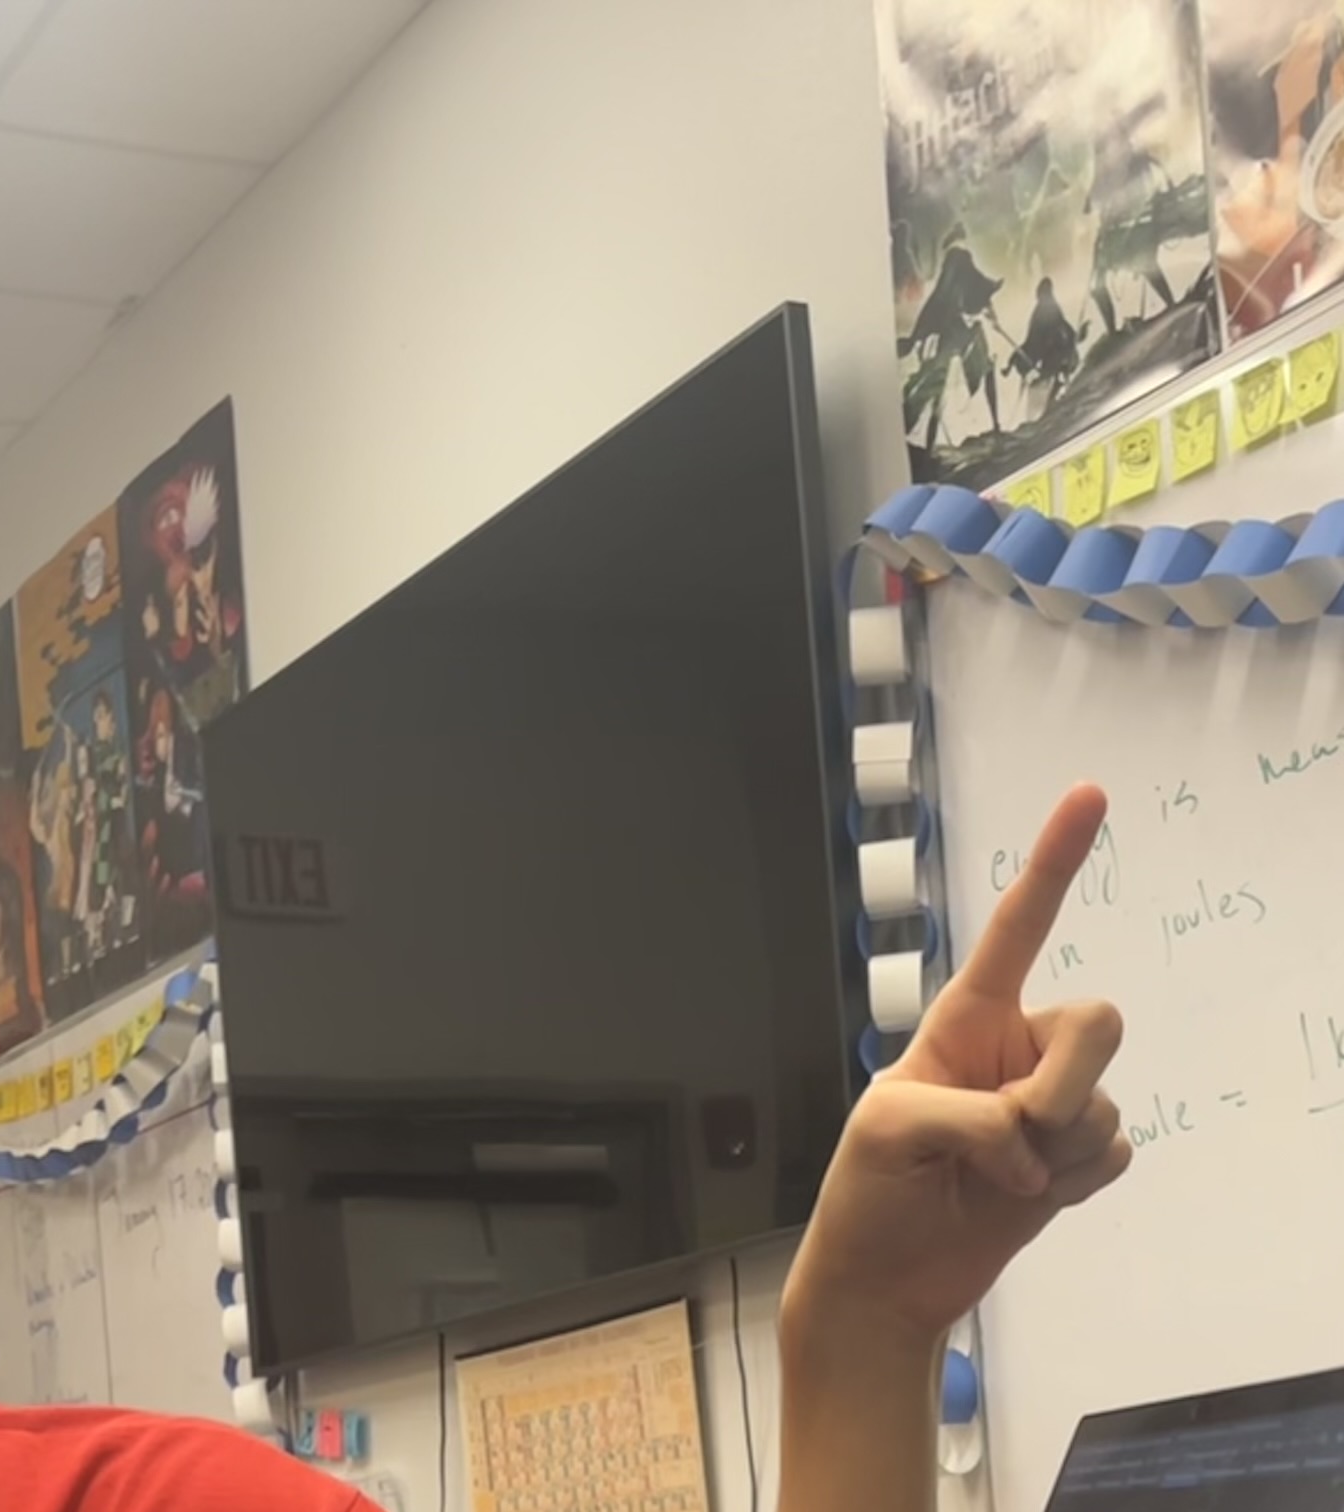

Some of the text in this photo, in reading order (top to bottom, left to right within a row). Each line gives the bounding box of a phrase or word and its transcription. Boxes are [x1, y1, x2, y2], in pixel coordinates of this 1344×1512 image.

[1155, 779, 1199, 823] is
[1160, 879, 1267, 966] joules
[1128, 1093, 1195, 1148] oule
